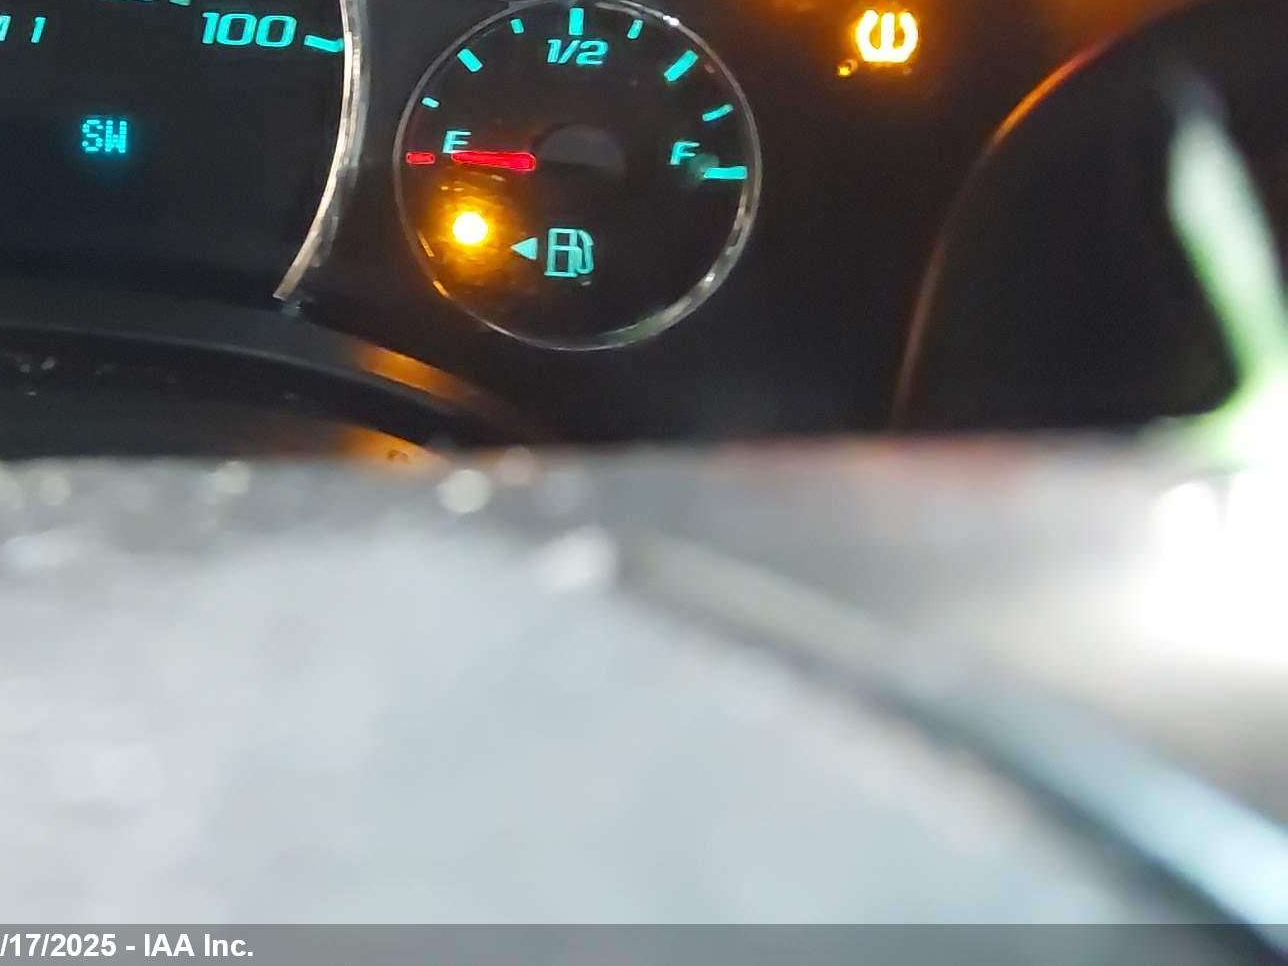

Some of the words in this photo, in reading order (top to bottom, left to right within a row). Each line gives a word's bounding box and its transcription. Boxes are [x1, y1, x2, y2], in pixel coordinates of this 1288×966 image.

[201, 12, 297, 48] 100
[546, 39, 609, 66] 1/2
[81, 117, 128, 154] SW
[669, 141, 701, 165] F
